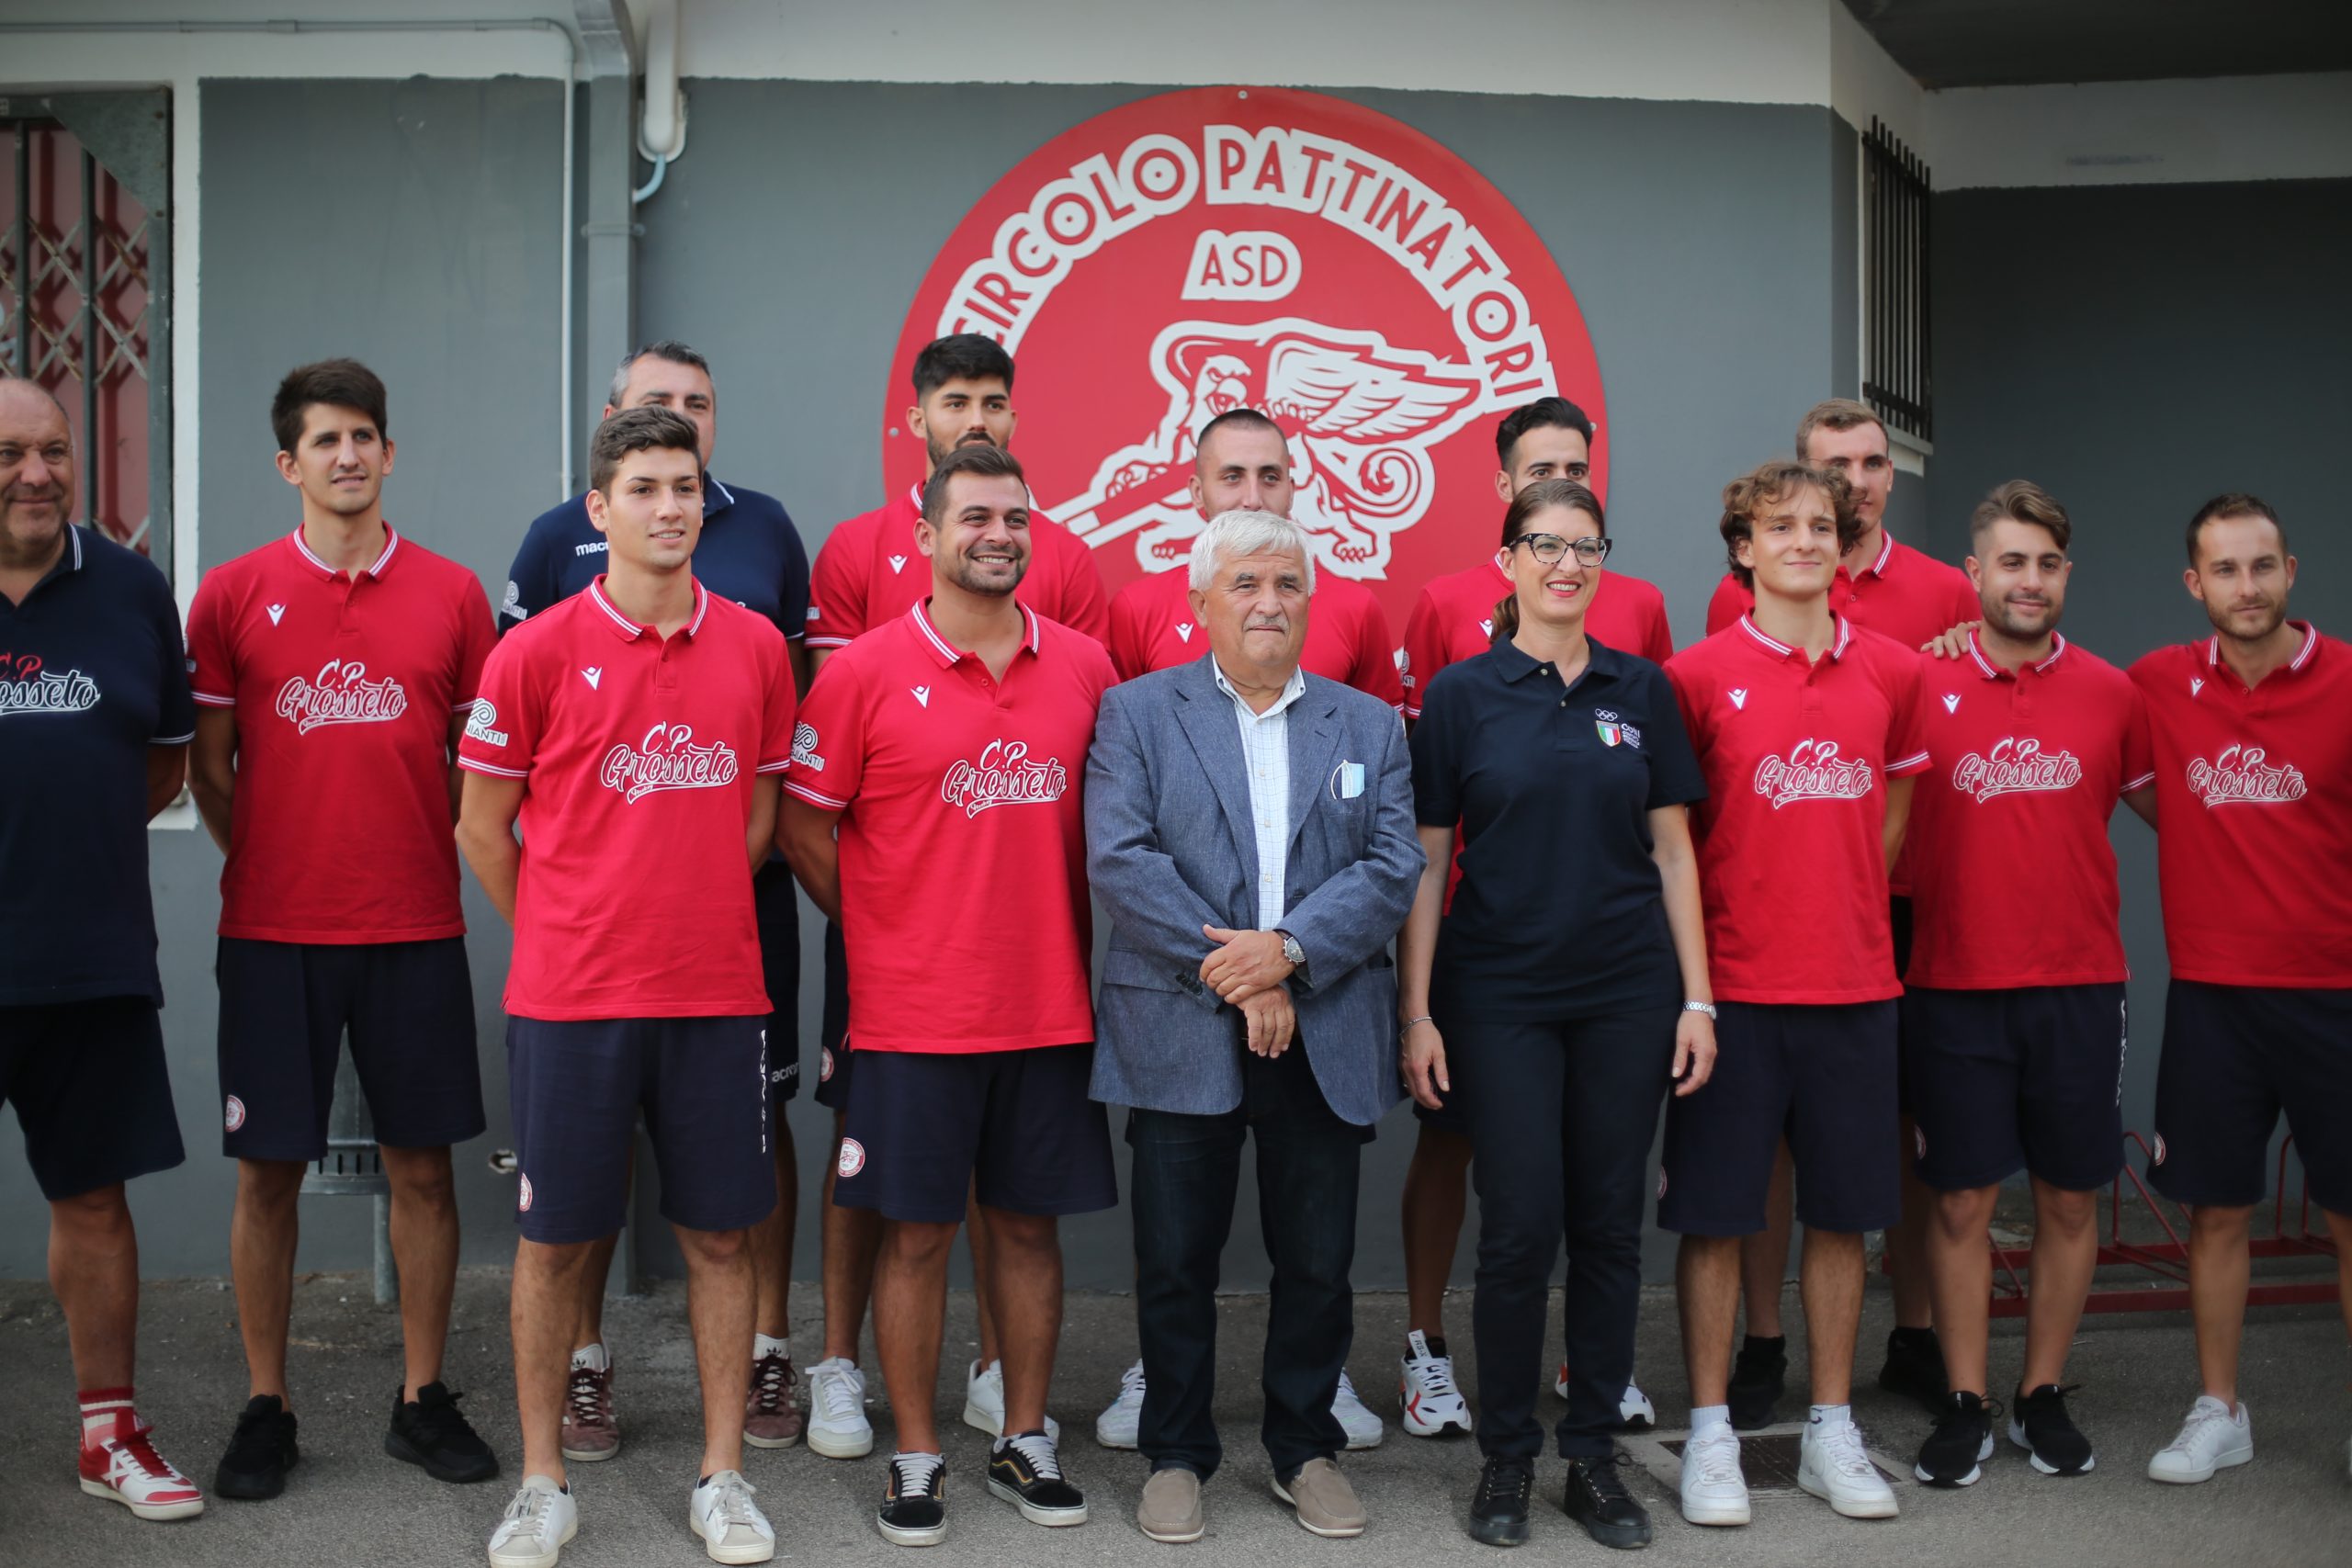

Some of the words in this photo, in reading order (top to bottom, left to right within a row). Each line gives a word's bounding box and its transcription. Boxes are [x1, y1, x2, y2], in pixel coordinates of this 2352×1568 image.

[951, 147, 1187, 348] IRCOLO
[1217, 137, 1545, 399] PATTINATORI
[1199, 243, 1289, 288] ASD
[276, 676, 408, 723] Grosseto
[600, 740, 739, 793] Grosseto
[941, 757, 1068, 807] Grosseto
[1754, 754, 1873, 799] Grosseto
[1952, 750, 2083, 795] Grosseto
[2187, 757, 2308, 801] Grosseto
